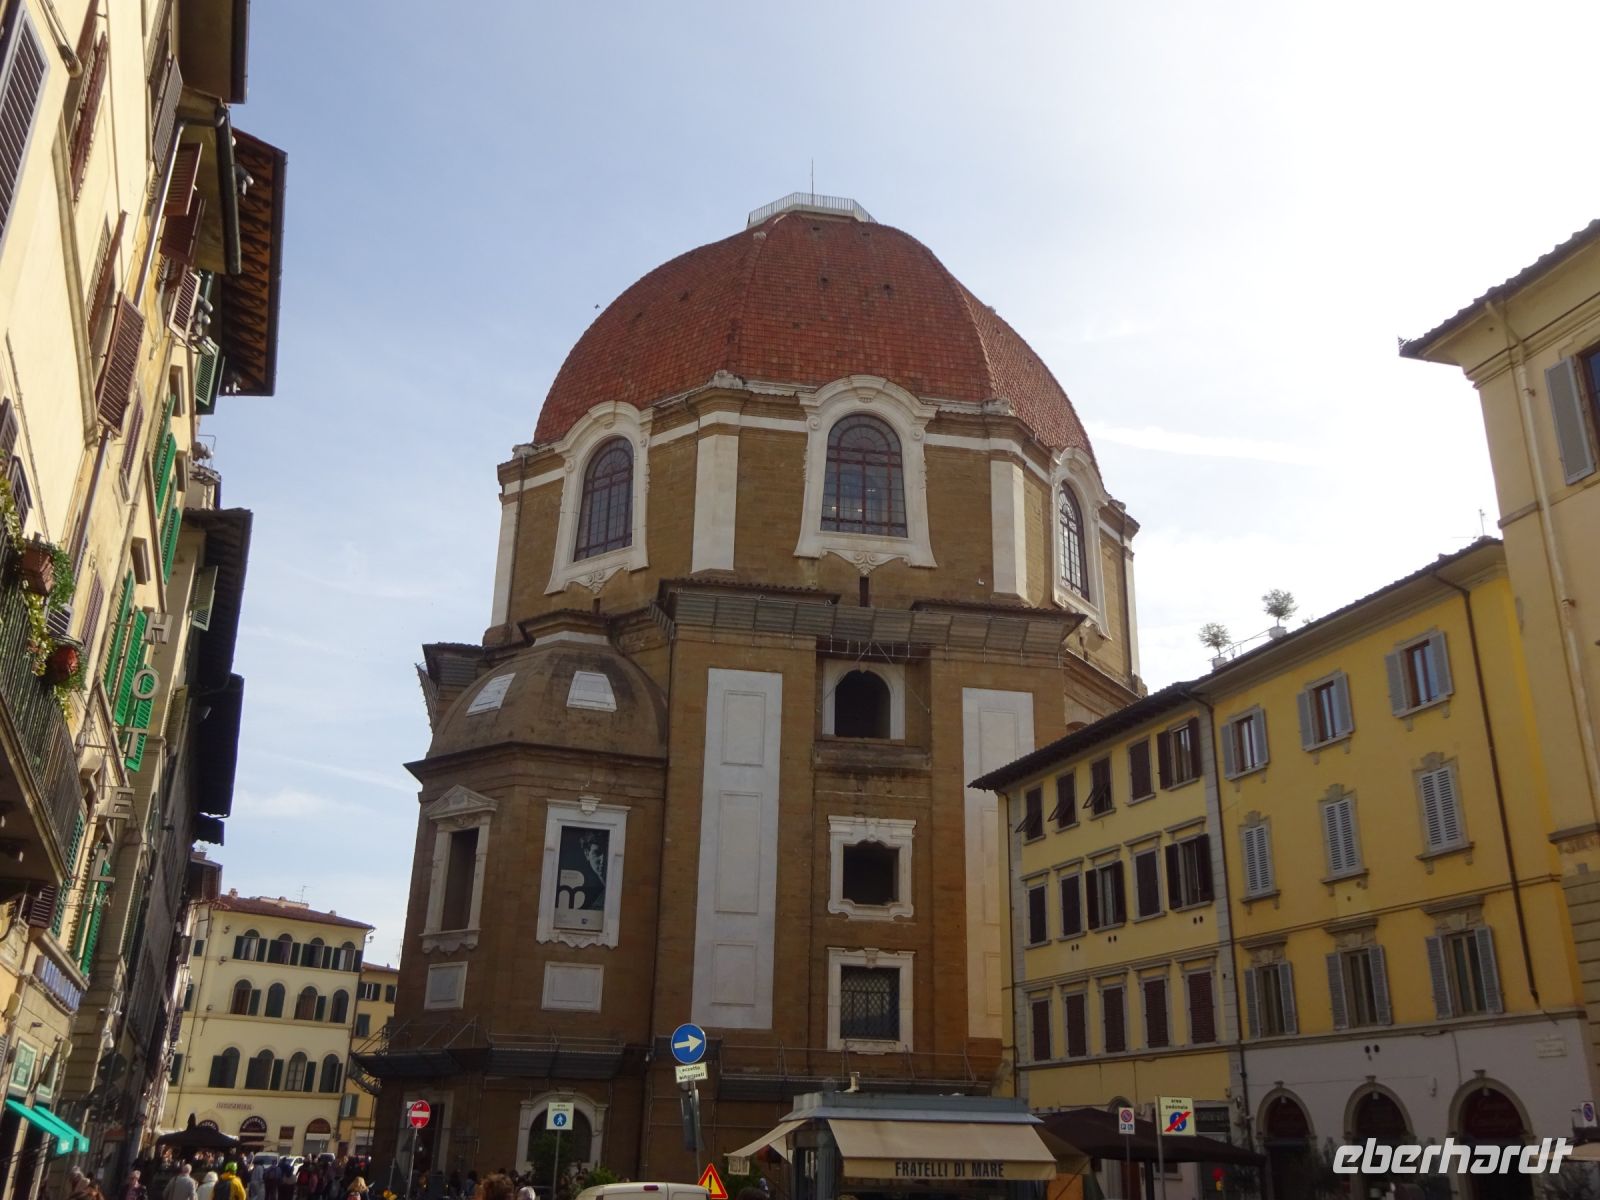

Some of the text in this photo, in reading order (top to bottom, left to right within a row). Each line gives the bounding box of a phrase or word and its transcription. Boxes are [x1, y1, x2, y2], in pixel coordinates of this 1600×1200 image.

[92, 611, 173, 883] HOTEL
[895, 1161, 1005, 1178] FRATELLI DI MARE
